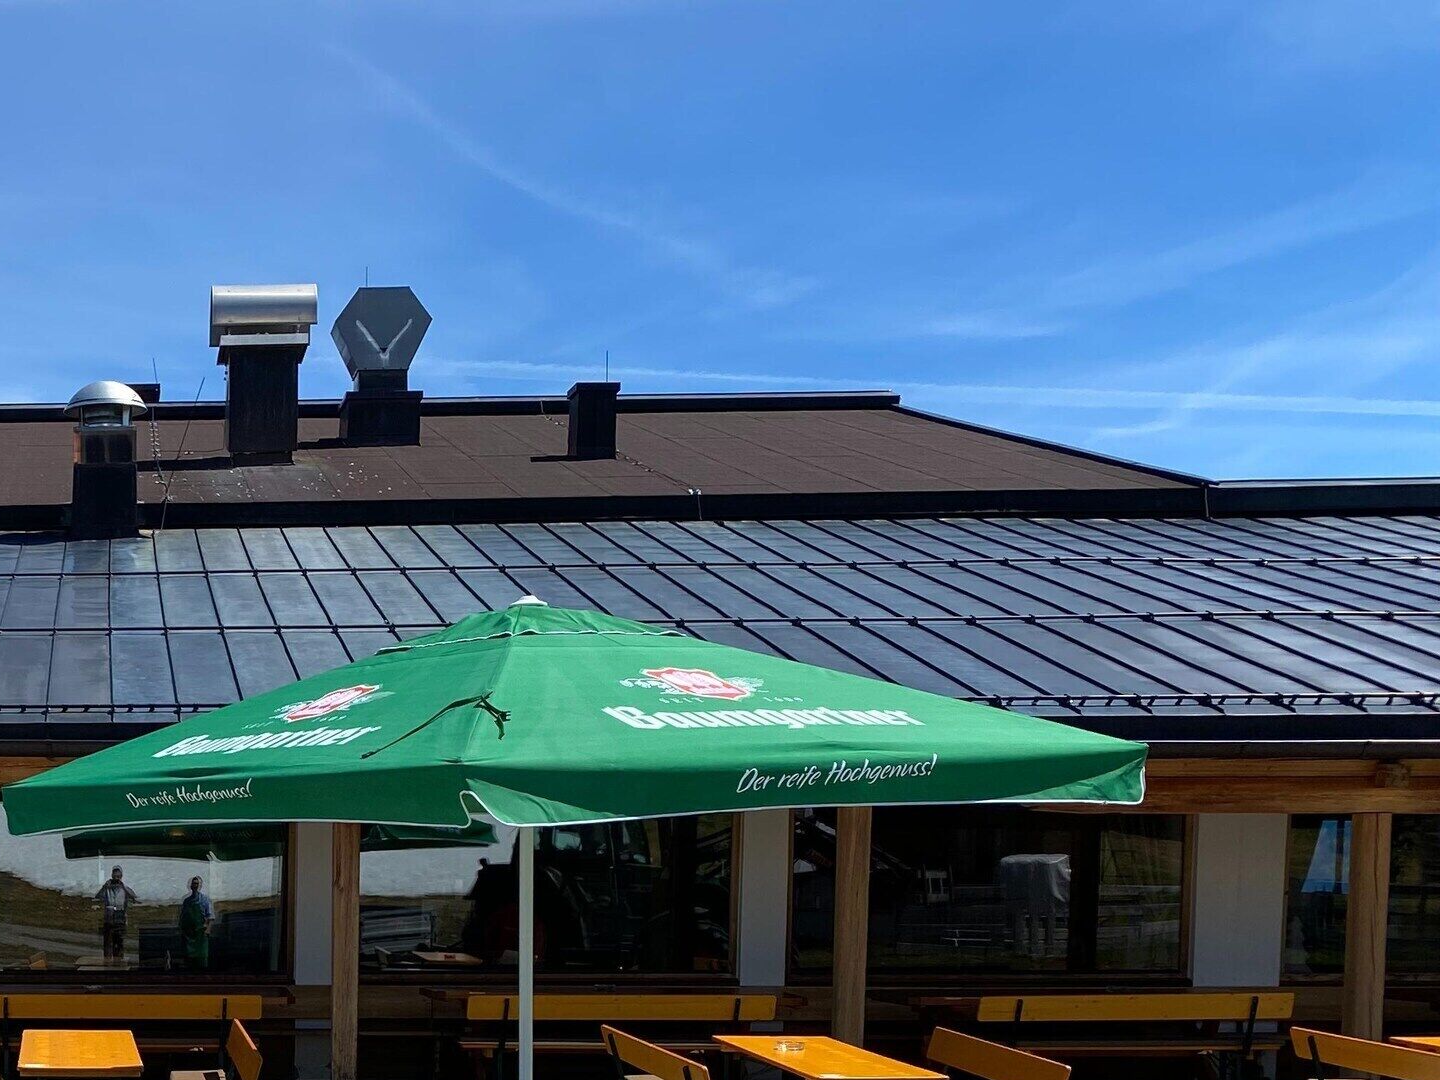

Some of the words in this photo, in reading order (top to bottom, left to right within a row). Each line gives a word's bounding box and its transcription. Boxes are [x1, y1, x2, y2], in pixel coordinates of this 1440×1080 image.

[735, 767, 771, 794] Der
[777, 765, 822, 790] reife
[824, 752, 938, 786] Hochgenuss!
[125, 791, 150, 809] Der
[149, 788, 177, 806] reife
[176, 777, 253, 804] Hochgenuss!
